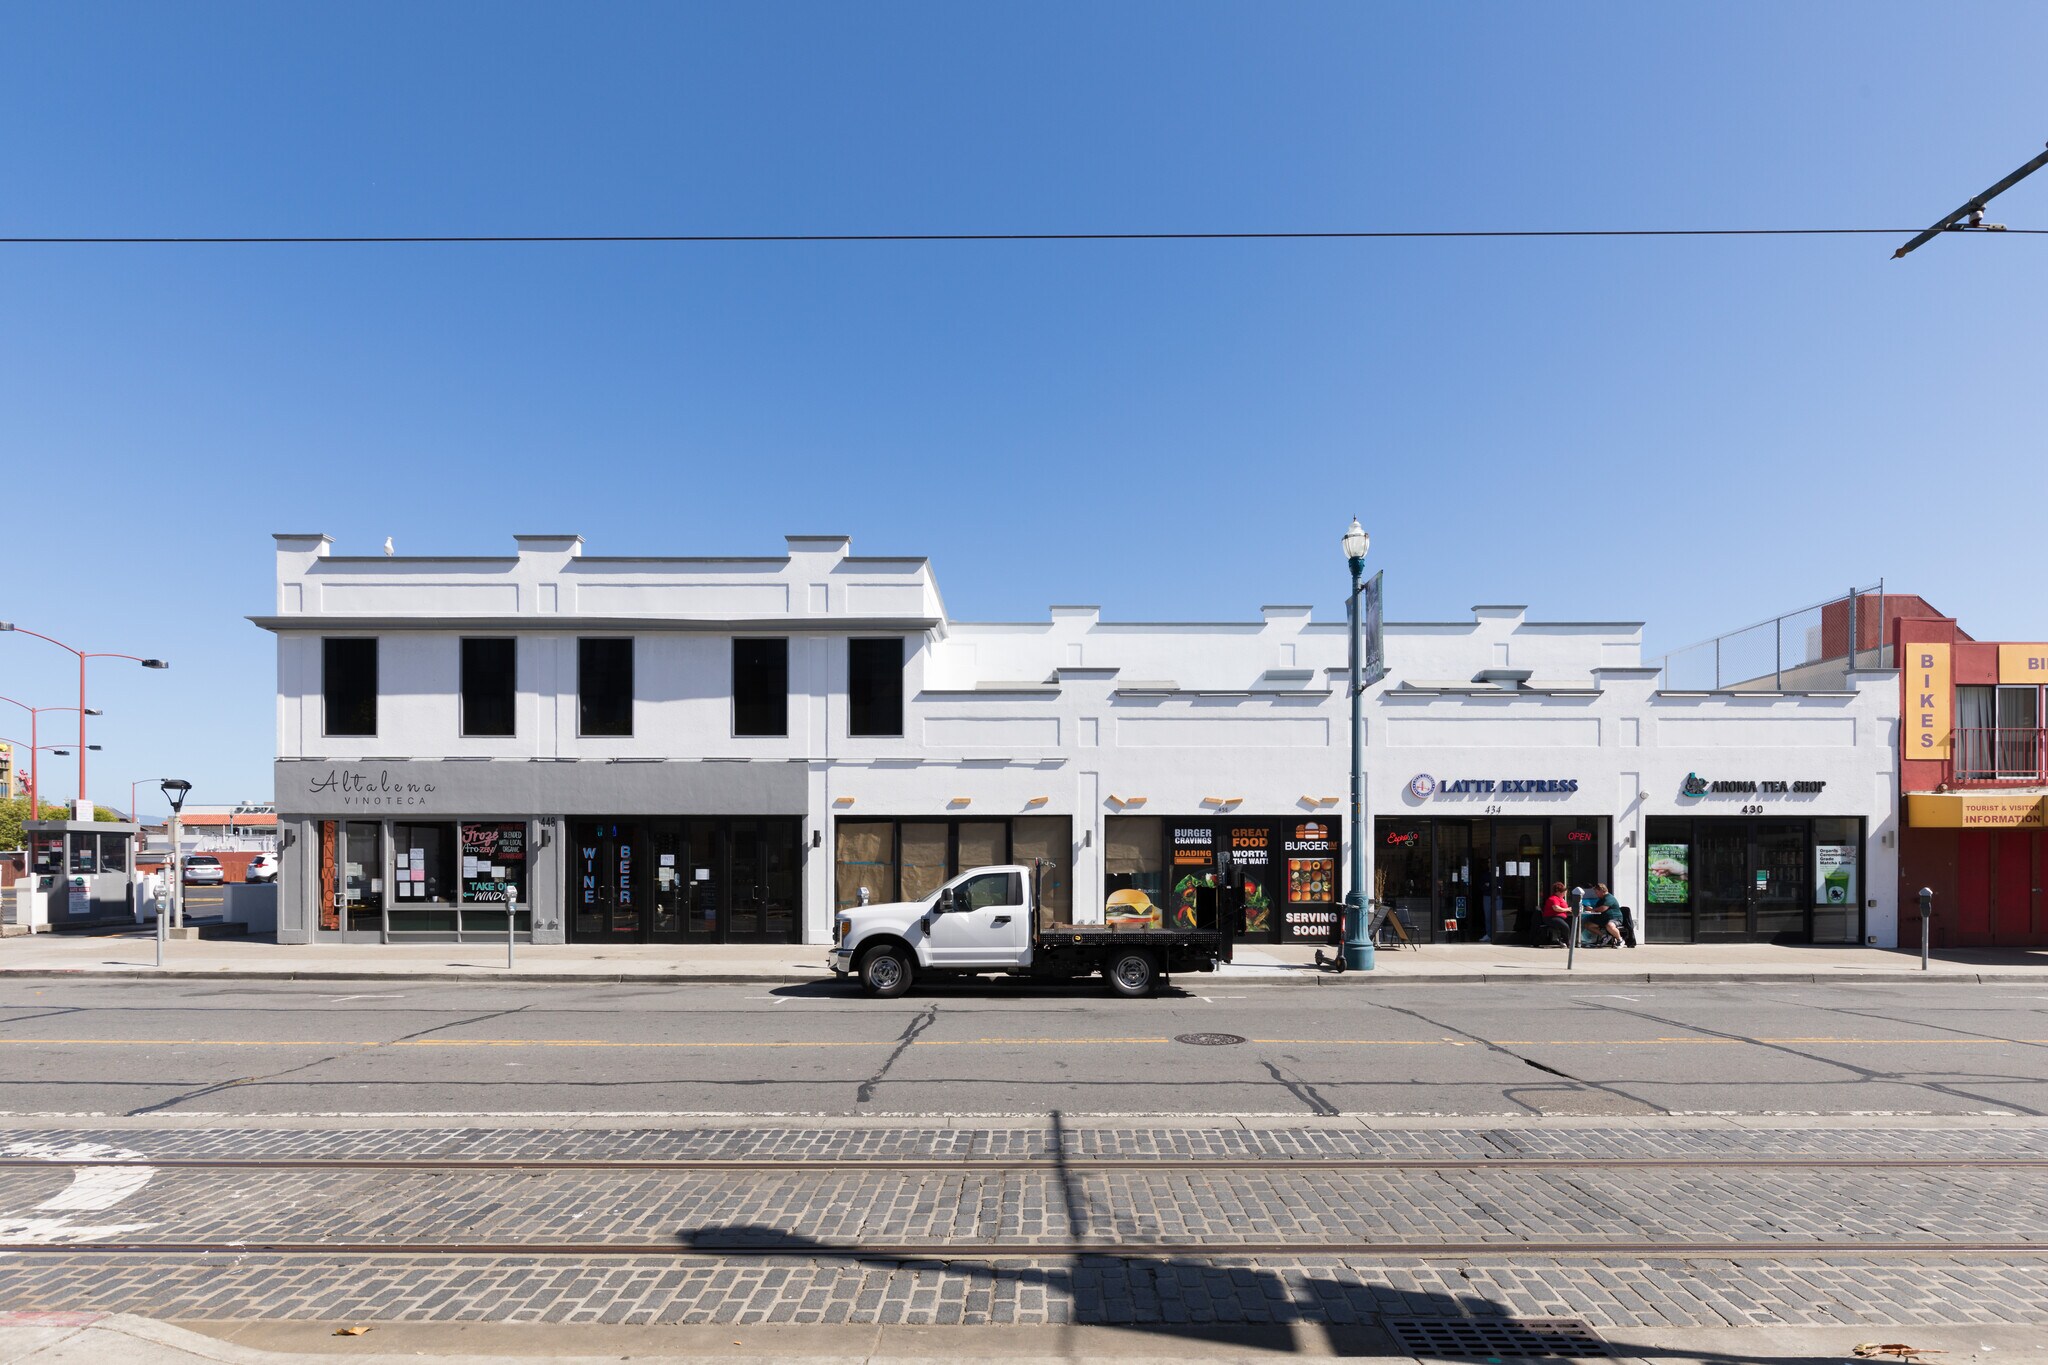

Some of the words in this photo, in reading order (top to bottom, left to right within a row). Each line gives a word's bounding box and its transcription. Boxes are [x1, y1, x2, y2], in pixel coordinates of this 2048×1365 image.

[2027, 657, 2048, 670] BI
[1920, 654, 1935, 748] BIKES
[309, 769, 436, 793] Altalena
[1440, 779, 1495, 793] LATTE
[1501, 778, 1579, 793] EXPRESS
[1711, 780, 1757, 793] AROMA
[1762, 780, 1789, 793] TEA
[1793, 780, 1827, 793] SHOP
[344, 797, 426, 805] VINOTECA
[1484, 805, 1501, 815] 434
[1742, 805, 1763, 814] 430
[540, 816, 556, 827] 448
[1965, 815, 2041, 823] INFORMATION
[1174, 829, 1212, 837] BURGER
[1231, 828, 1269, 837] GREAT
[1567, 832, 1592, 841] OPEN
[1174, 837, 1212, 845] CRAVINGS
[1232, 838, 1268, 847] FOOD
[1285, 841, 1338, 851] BURGERIM
[582, 847, 597, 904] WINE
[619, 845, 632, 904] BEER
[469, 882, 495, 891] TAKE
[1285, 912, 1338, 923] SERVING
[1293, 925, 1330, 936] SOON!
